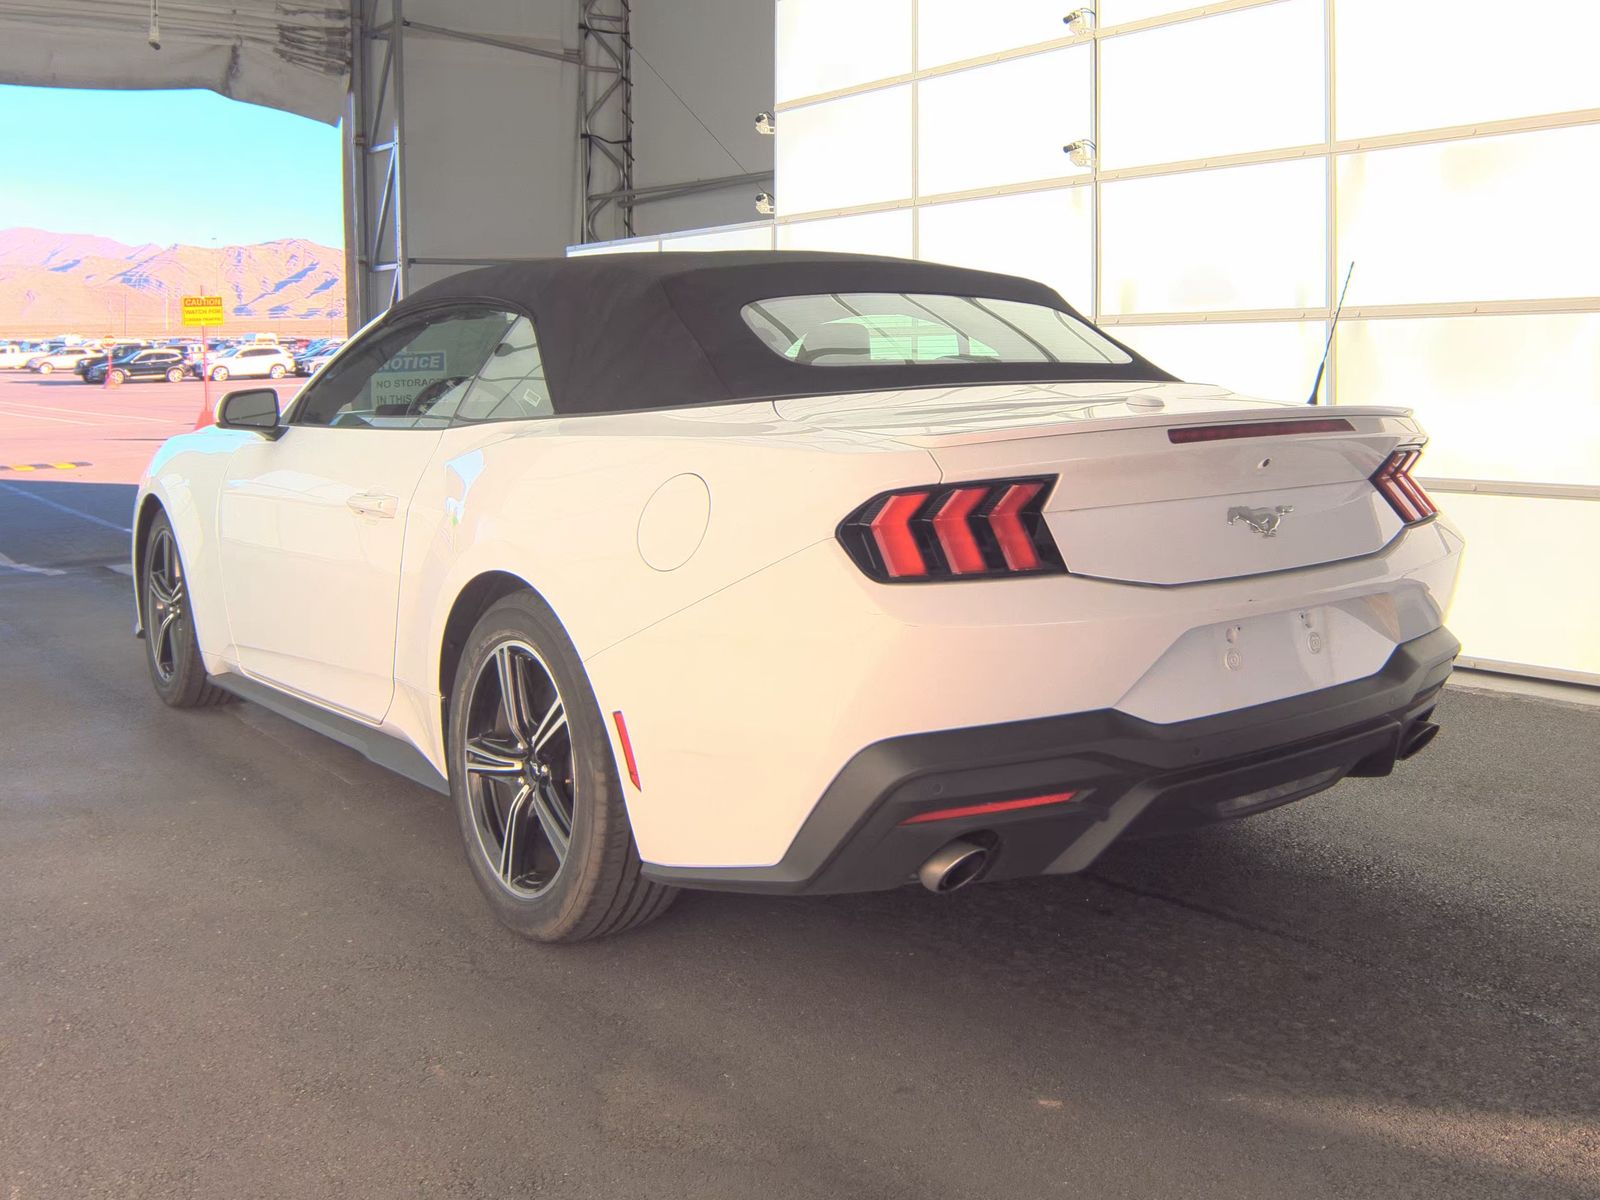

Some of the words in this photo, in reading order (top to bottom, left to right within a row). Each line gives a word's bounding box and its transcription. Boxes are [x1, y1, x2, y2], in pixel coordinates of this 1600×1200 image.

[185, 298, 221, 306] CAUTION
[376, 379, 392, 389] NO
[376, 395, 387, 405] IN
[390, 394, 412, 404] THIS
